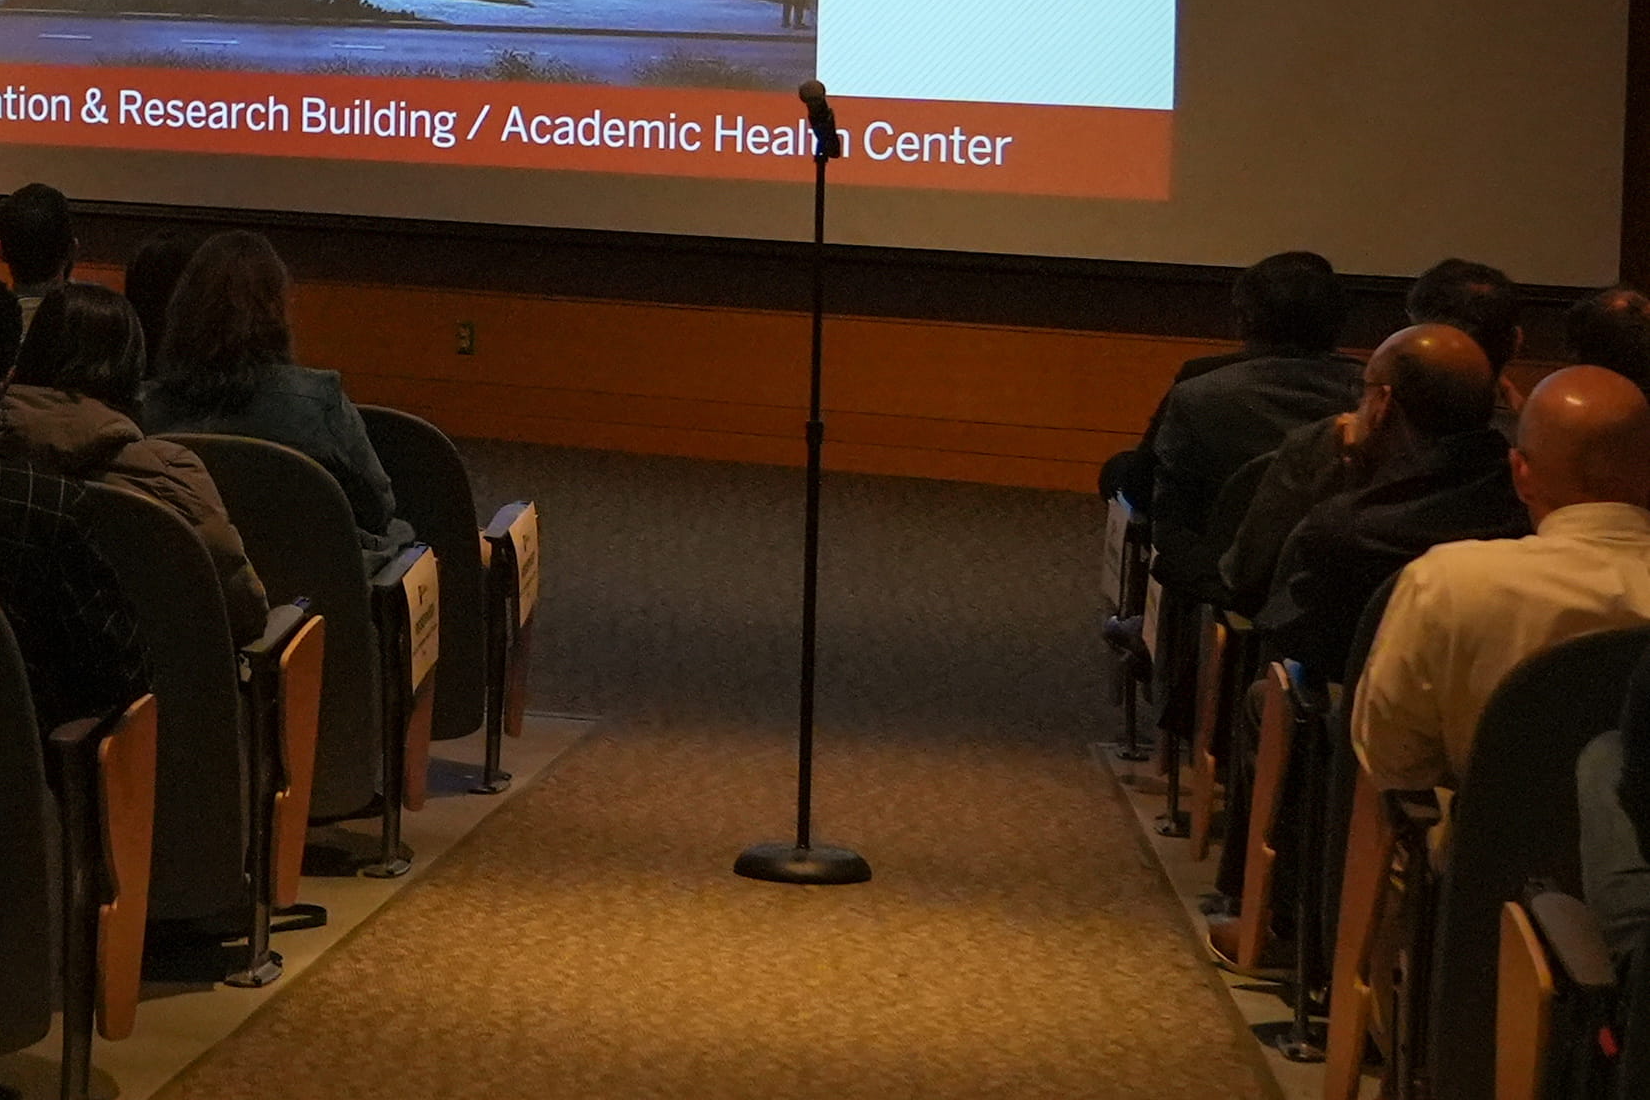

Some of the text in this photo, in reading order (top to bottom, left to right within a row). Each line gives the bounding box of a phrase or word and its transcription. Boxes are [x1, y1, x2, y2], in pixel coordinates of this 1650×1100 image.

[80, 87, 110, 125] &
[119, 89, 290, 132] Research
[301, 96, 458, 149] Building
[466, 104, 491, 140] /
[500, 105, 702, 152] Academic
[863, 121, 1013, 166] Center
